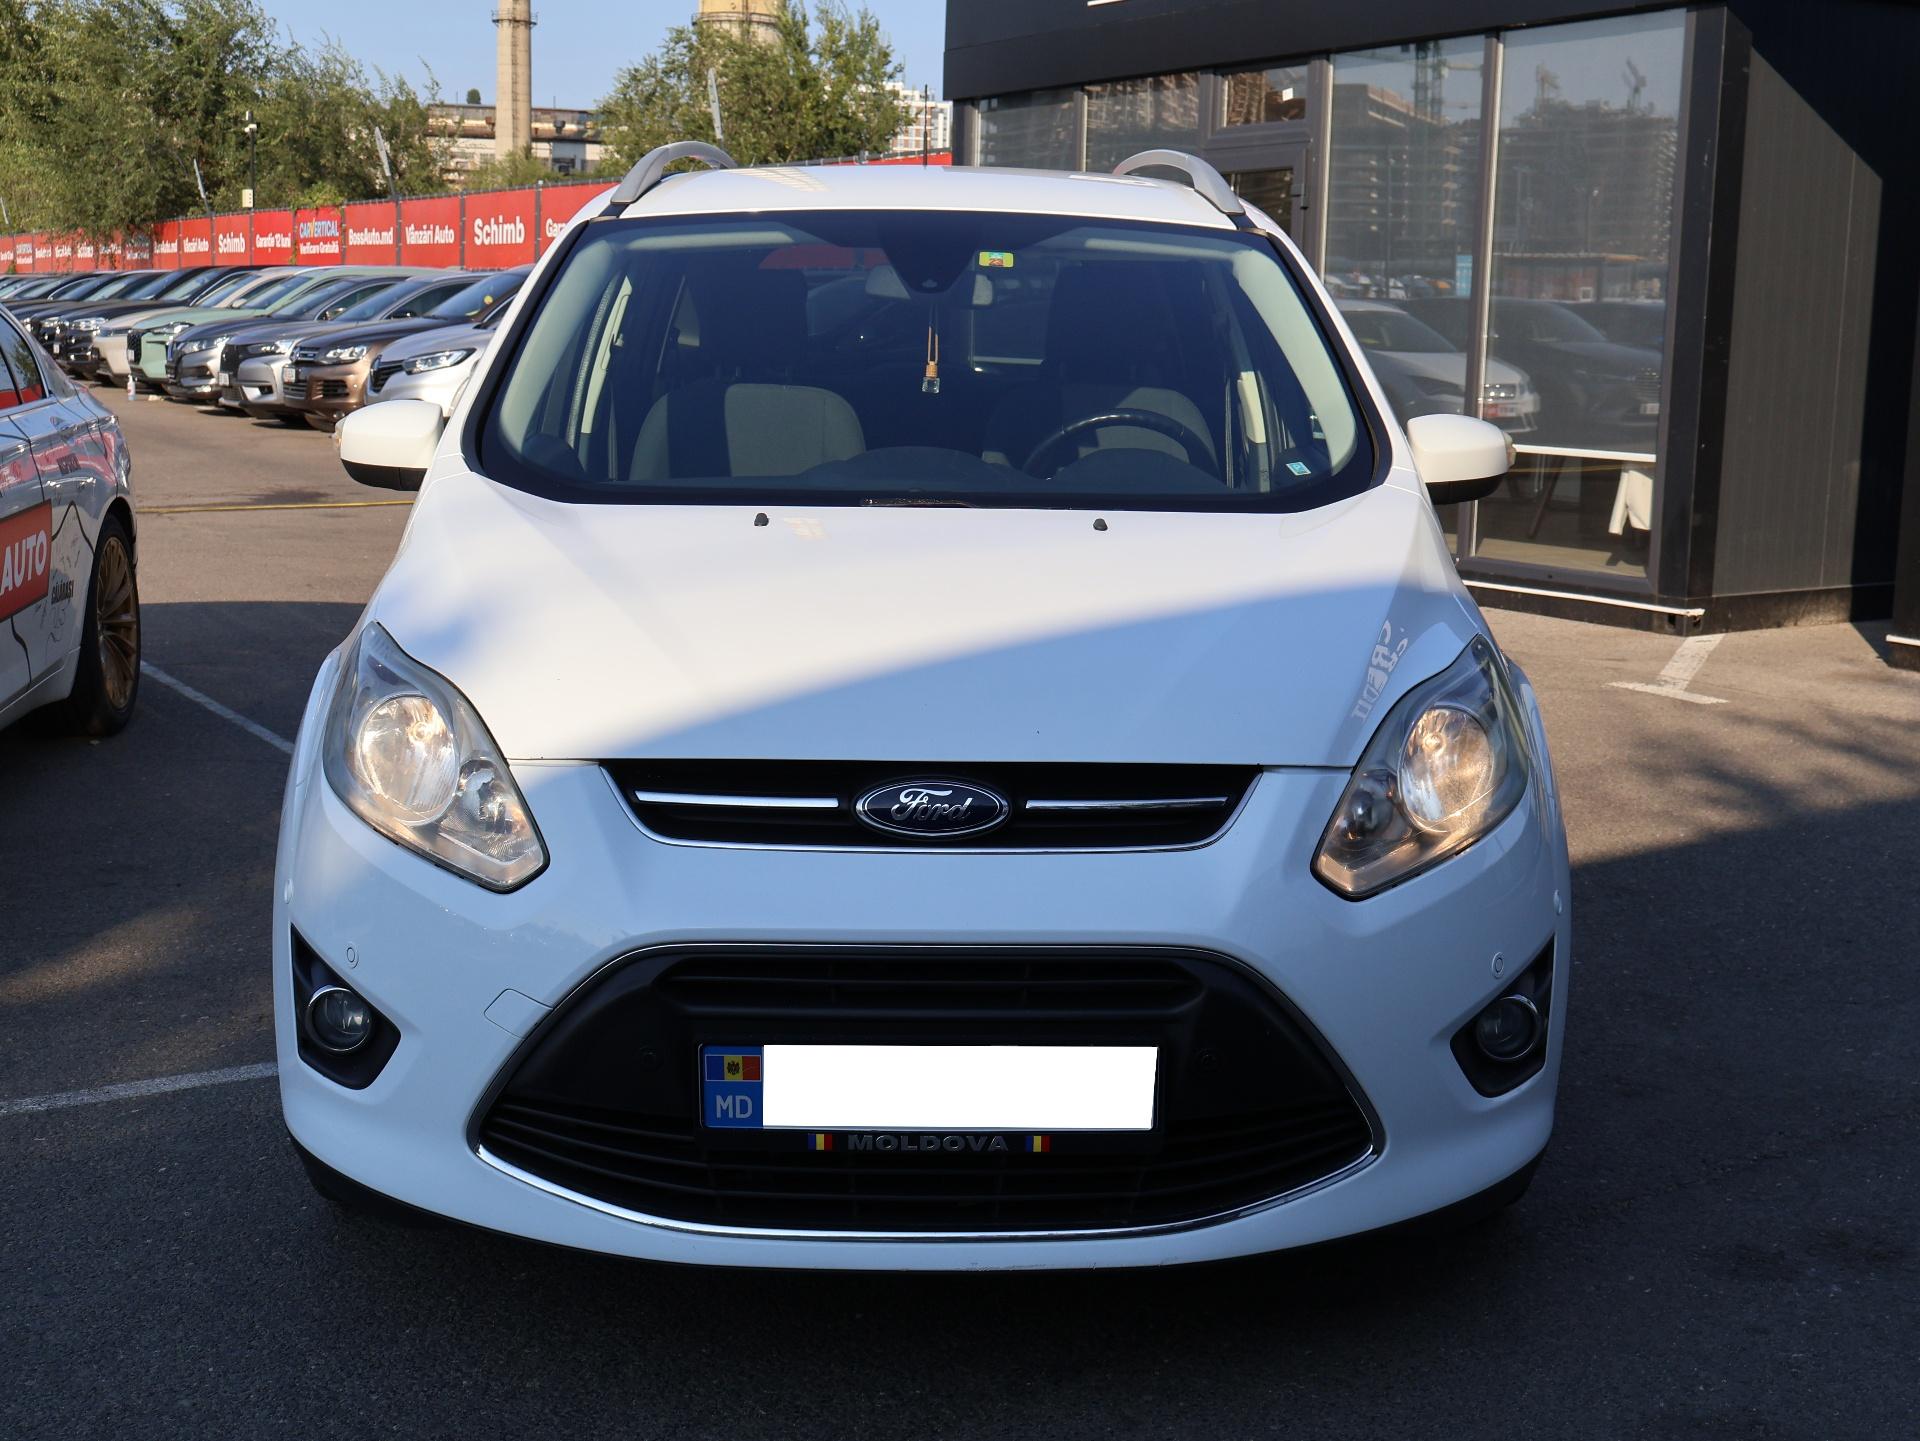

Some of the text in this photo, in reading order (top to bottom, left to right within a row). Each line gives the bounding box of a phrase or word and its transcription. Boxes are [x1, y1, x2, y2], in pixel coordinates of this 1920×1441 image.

[348, 226, 394, 246] BossAuto.md
[405, 223, 455, 245] Vânzări Auto
[474, 215, 526, 245] Schimb
[218, 232, 246, 253] Schimb
[0, 530, 48, 596] AUTO
[891, 788, 974, 821] Ford
[715, 1095, 753, 1119] MD
[848, 1134, 1009, 1151] MOLDOVA
